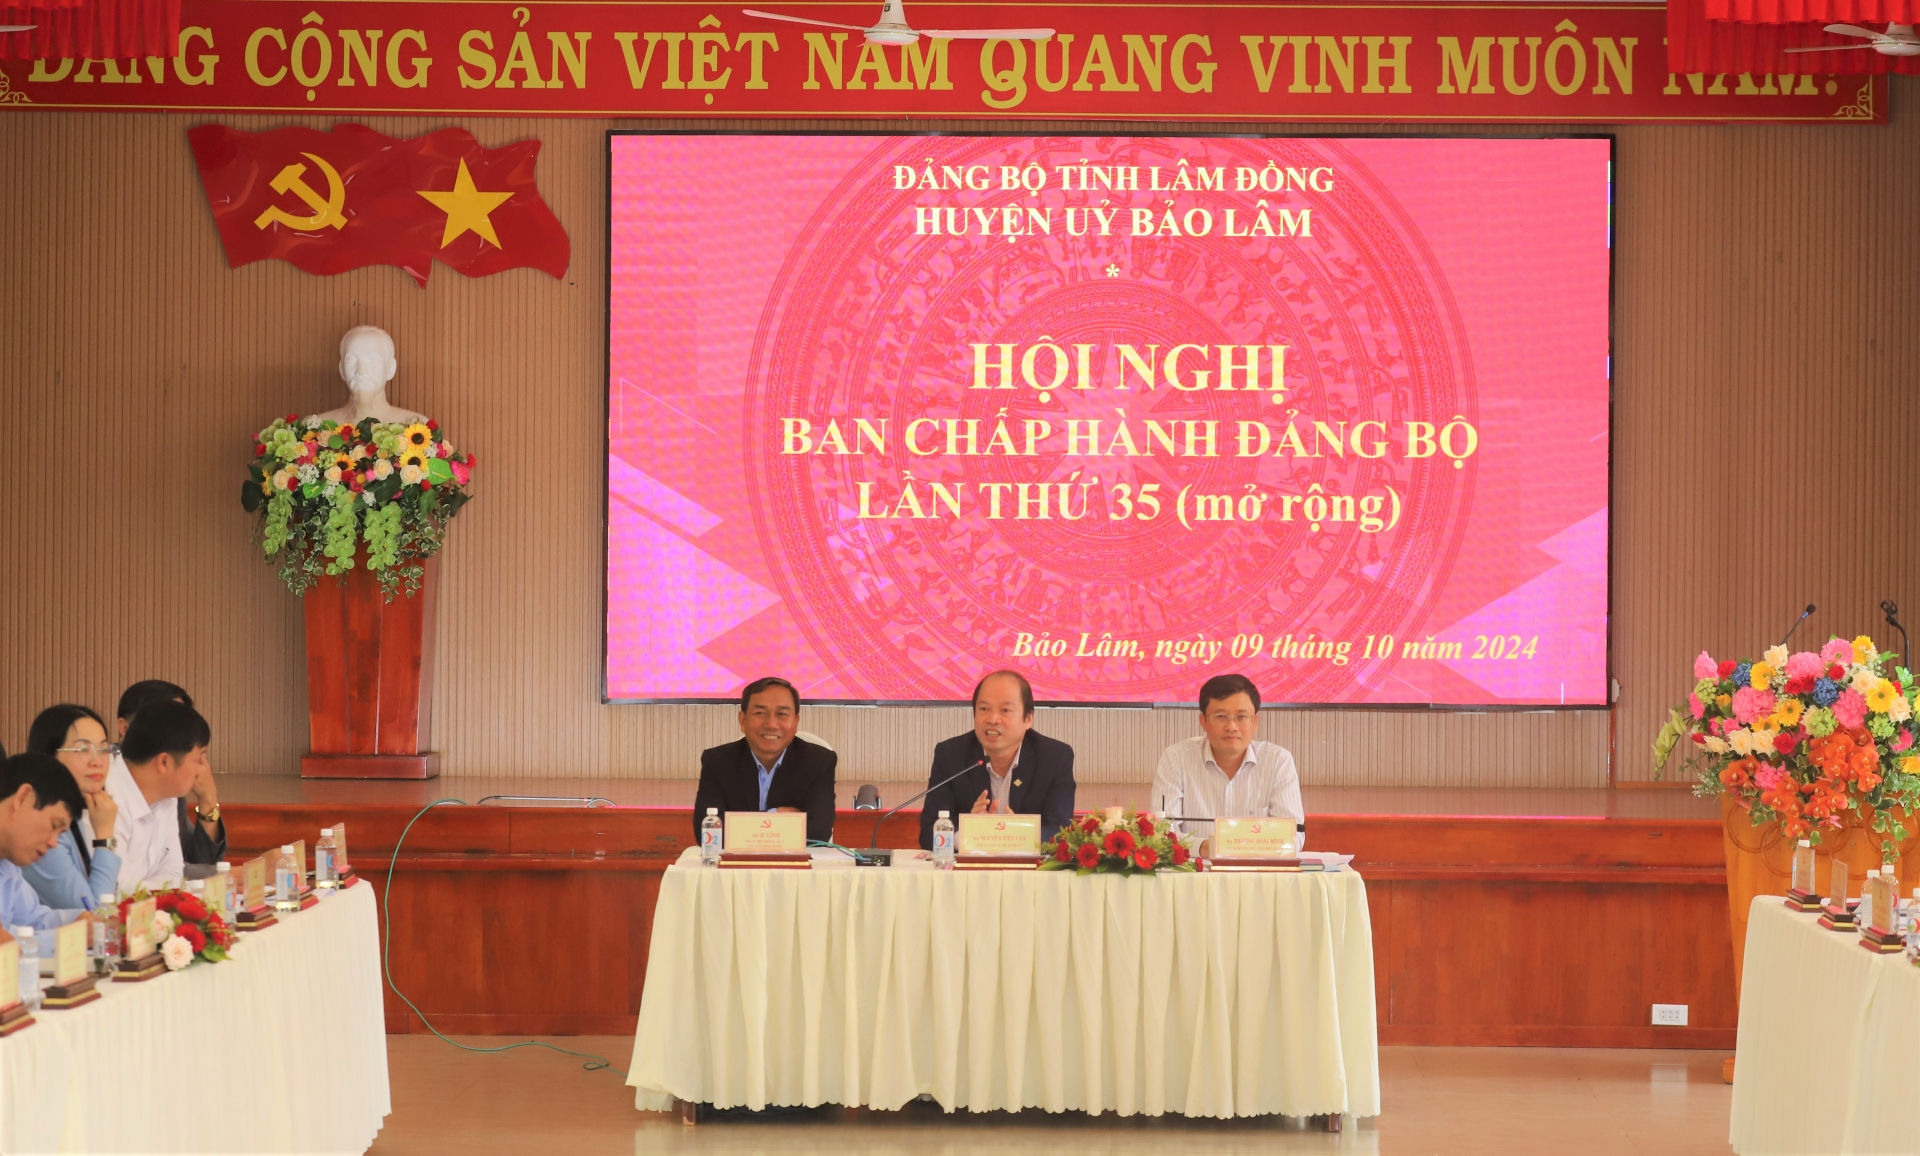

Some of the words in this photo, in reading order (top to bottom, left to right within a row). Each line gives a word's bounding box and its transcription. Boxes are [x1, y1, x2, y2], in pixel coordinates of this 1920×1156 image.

[245, 11, 433, 101] CỘNG
[457, 7, 592, 89] SẢN
[614, 14, 780, 105] VIỆT
[802, 32, 954, 91] NAM
[979, 34, 1218, 109] QUANG
[1239, 35, 1412, 94] VINH
[1437, 18, 1638, 96] MUÔN
[892, 157, 991, 191] ĐẢNG
[1000, 161, 1047, 198] BỘ
[1056, 157, 1140, 192] TỈNH
[1148, 158, 1225, 192] LÂM
[1234, 159, 1335, 193] ĐỒNG
[914, 202, 1053, 244] HUYỆN
[1065, 199, 1120, 237] UỶ
[1130, 199, 1213, 237] BẢO
[1224, 199, 1313, 238] LÂM
[968, 334, 1096, 404] HỘI
[1114, 343, 1291, 406] NGHỊ
[780, 417, 889, 456] BAN
[903, 407, 1052, 457] CHẤP
[1063, 407, 1221, 458] HÀNH
[1234, 408, 1389, 459] ĐẢNG
[1403, 414, 1479, 470] BỘ
[855, 469, 965, 520] LẦN
[978, 470, 1099, 521] THỨ
[1109, 482, 1161, 521] 35
[1176, 483, 1268, 531] (mở
[1280, 482, 1401, 533] rộng)
[1010, 631, 1068, 657] Bảo
[1074, 632, 1145, 662] Lâm,
[1154, 633, 1223, 665] ngày
[1231, 633, 1264, 659] 09
[1271, 633, 1353, 666] tháng
[1361, 634, 1395, 660] 10
[1401, 634, 1463, 660] năm
[1470, 634, 1539, 660] 2024
